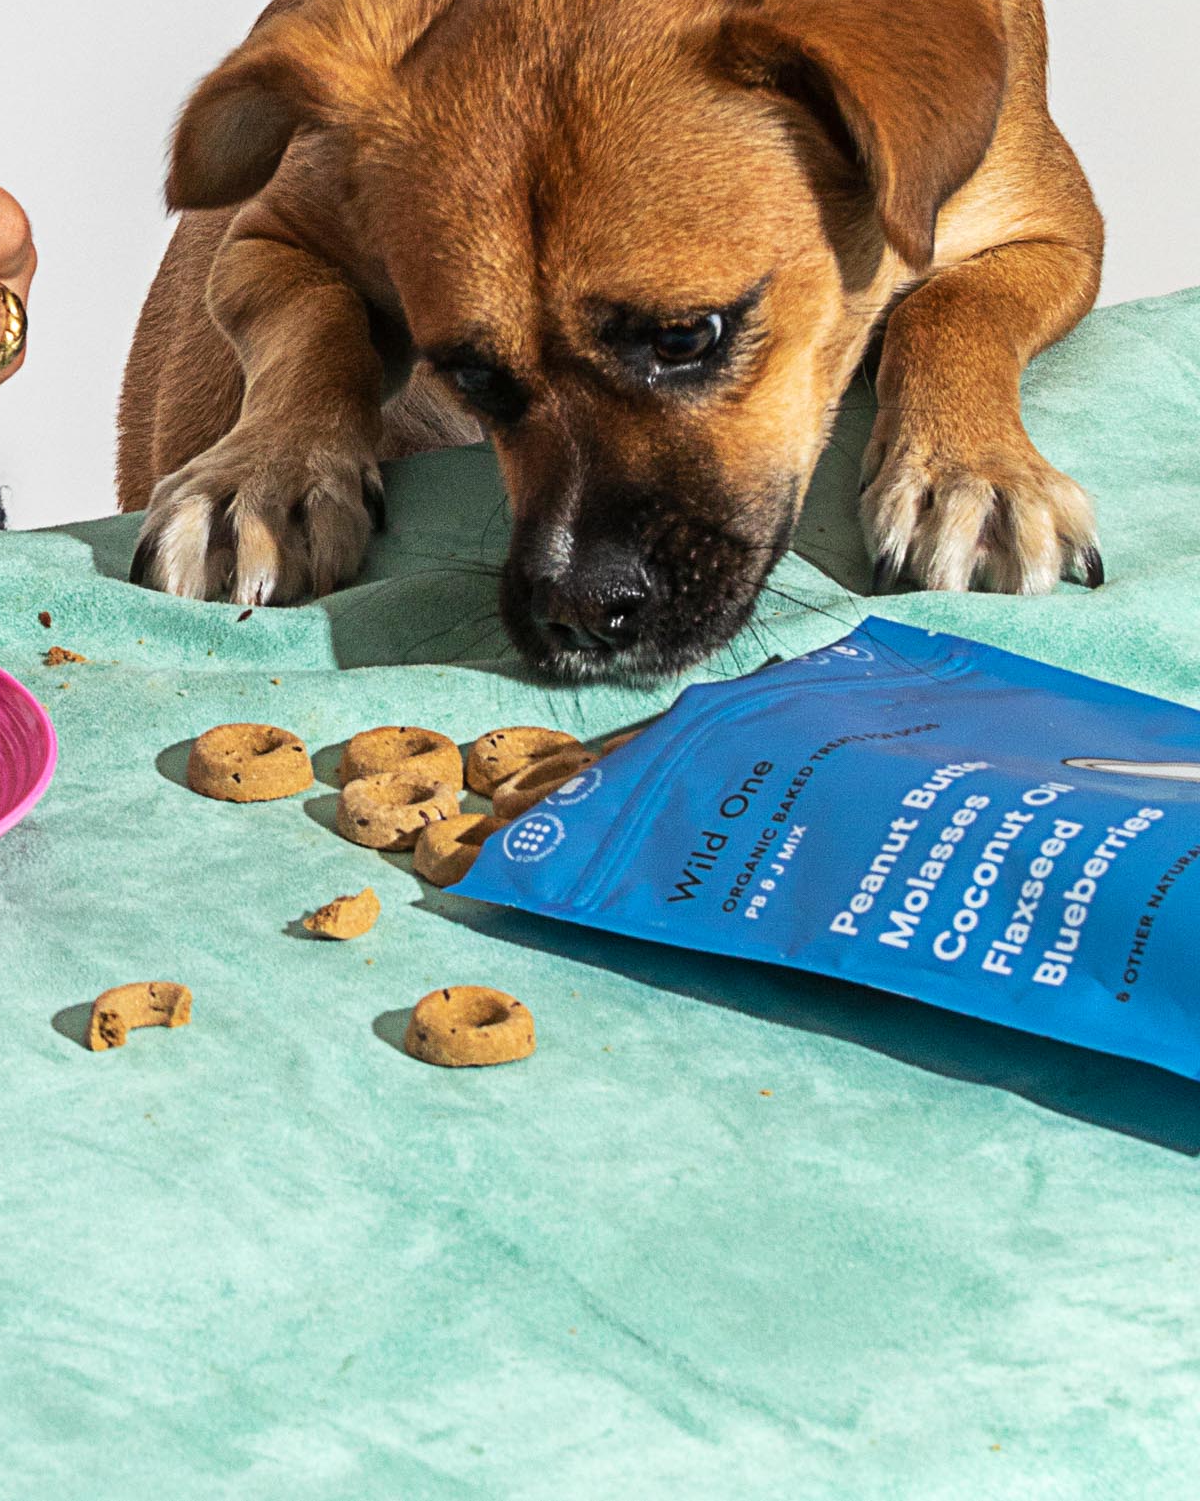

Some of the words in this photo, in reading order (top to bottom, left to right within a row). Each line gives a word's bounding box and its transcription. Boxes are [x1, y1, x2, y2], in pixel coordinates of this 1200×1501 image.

[667, 831, 729, 903] Wild
[719, 761, 774, 819] One
[722, 828, 777, 913] ORGANIC
[771, 766, 814, 823] BAKED
[771, 863, 785, 875] J
[777, 825, 807, 860] MIX
[829, 817, 919, 936] Peanut
[878, 795, 990, 949] Molasses
[933, 810, 1034, 961] Coconut
[1022, 781, 1075, 806] Oil
[982, 819, 1083, 975] Flaxseed
[1032, 807, 1164, 986] Blueberries
[745, 895, 767, 919] PB
[1123, 915, 1154, 985] OTHER
